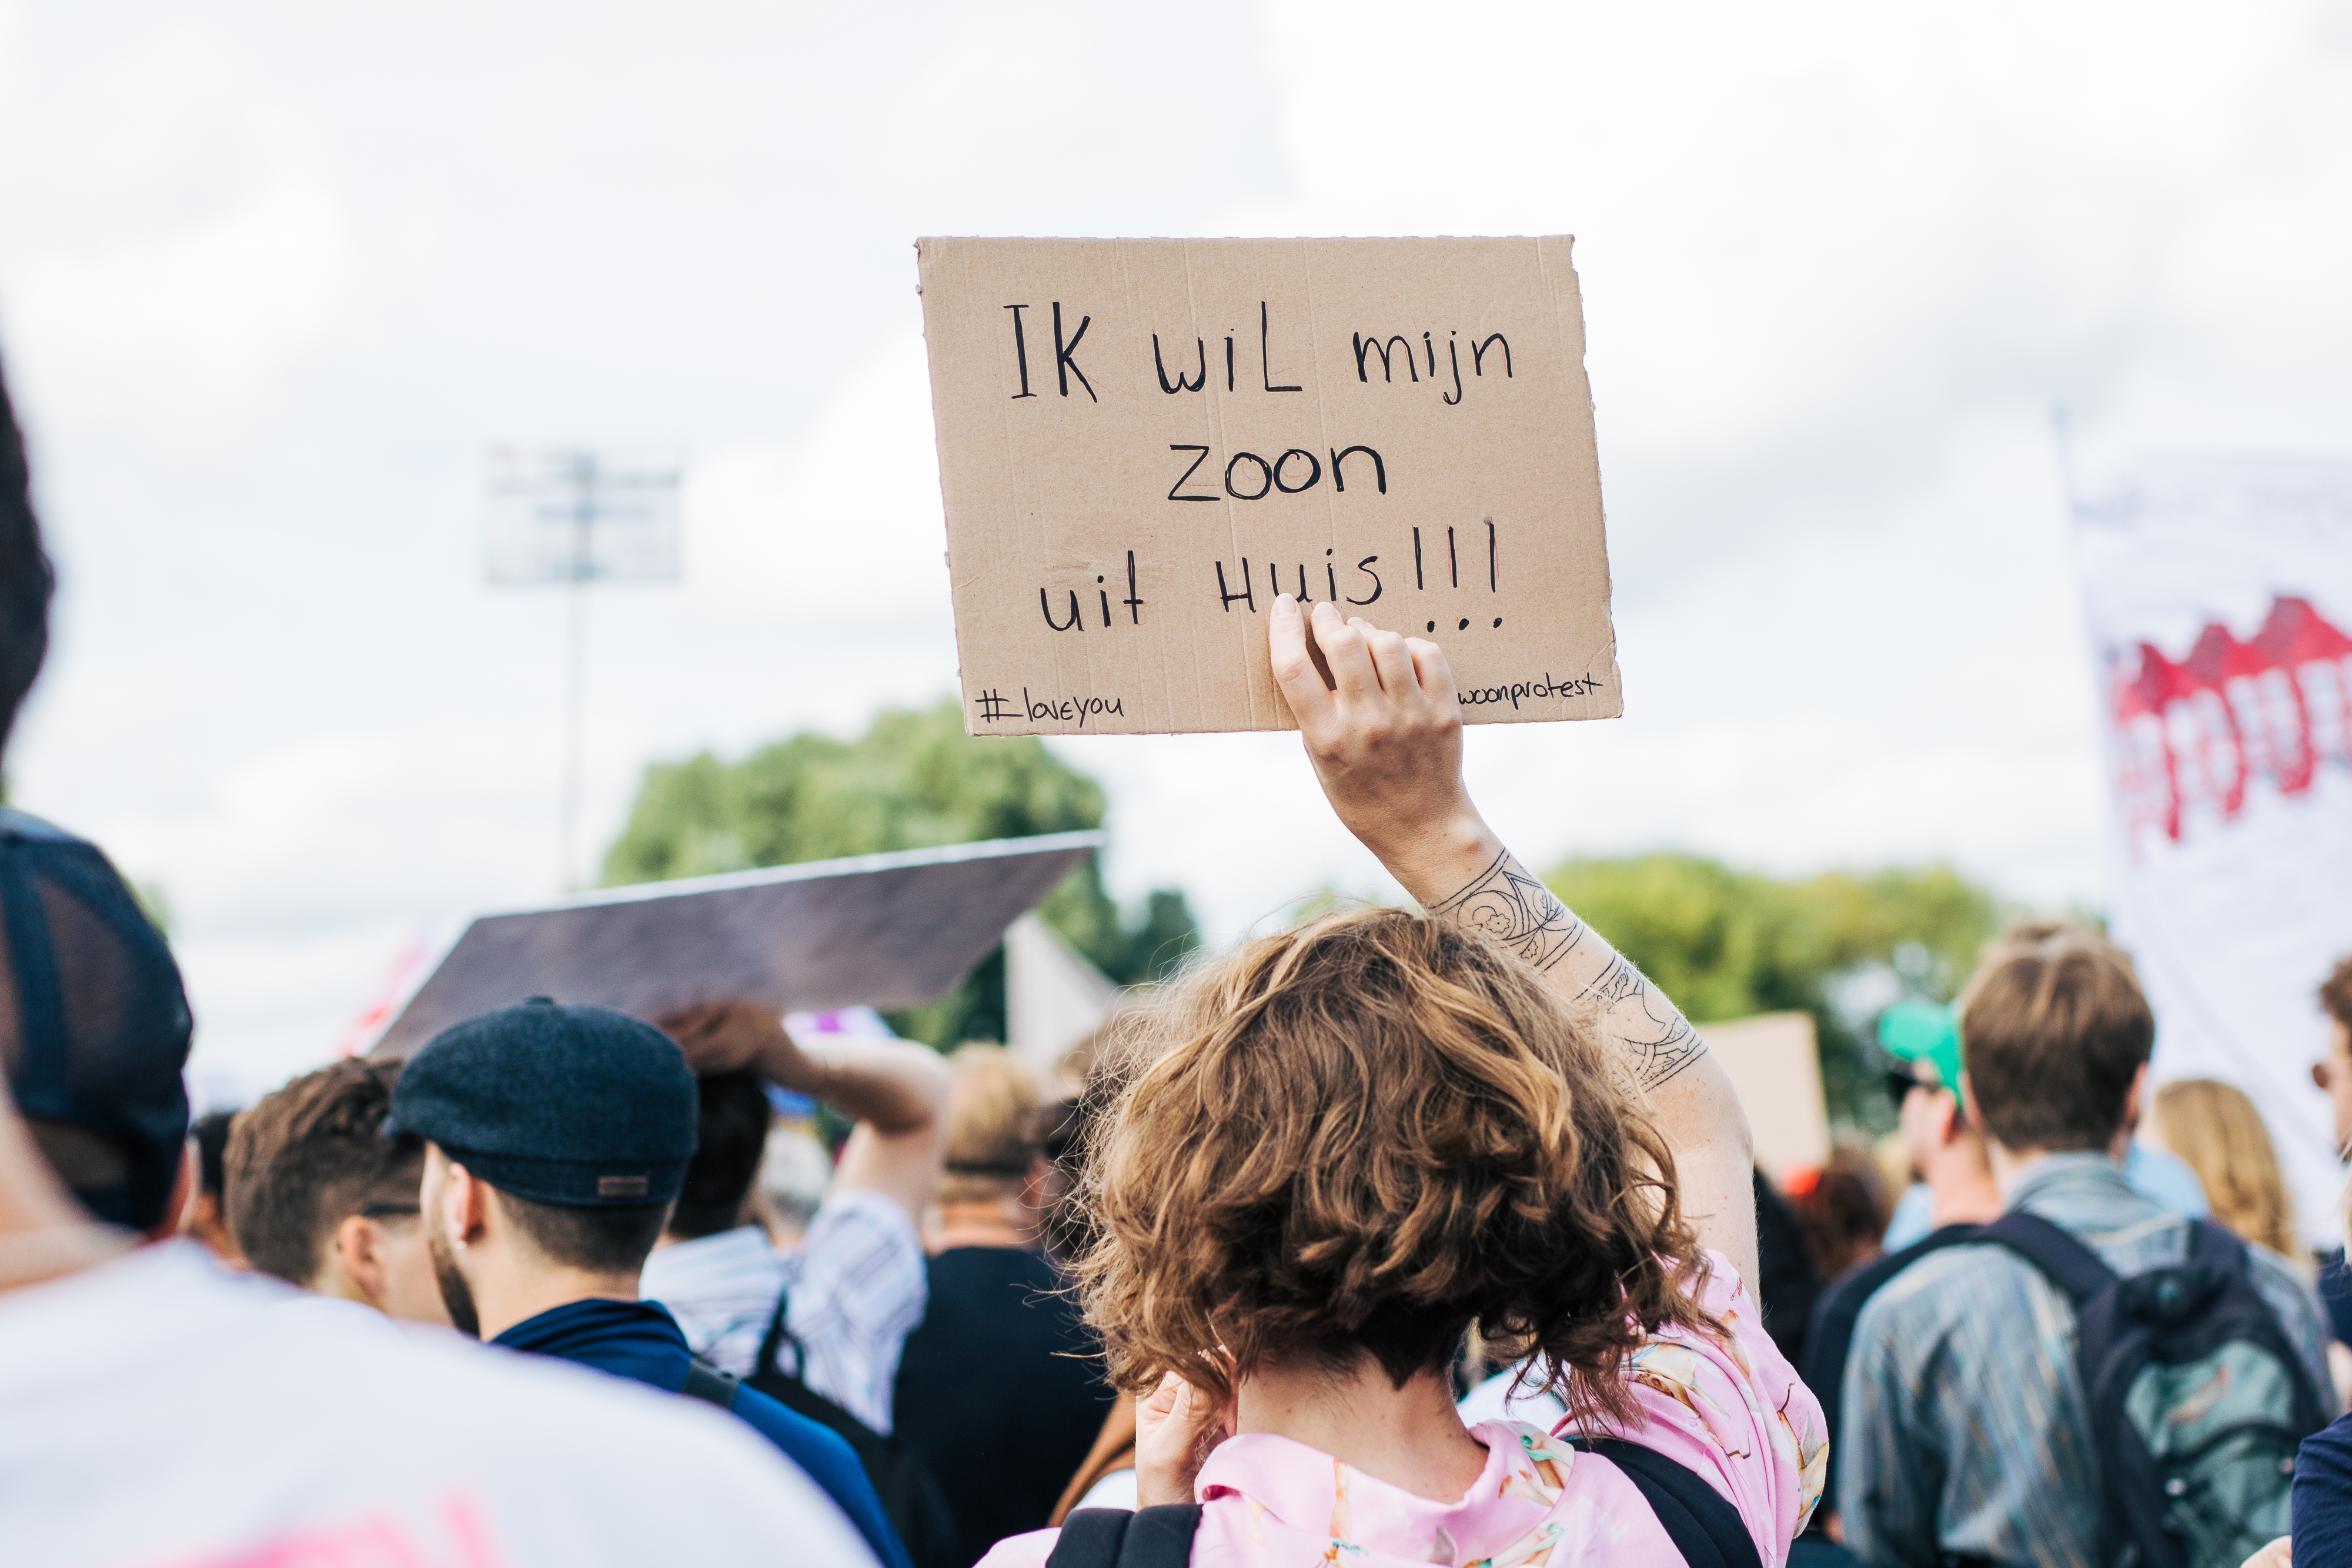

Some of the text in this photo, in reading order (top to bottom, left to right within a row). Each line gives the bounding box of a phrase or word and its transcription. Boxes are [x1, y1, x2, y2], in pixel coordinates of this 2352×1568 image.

[1352, 330, 1514, 406] mijn
[1167, 444, 1387, 502] zoon
[1039, 549, 1144, 632] uit
[974, 686, 1125, 728] #loveyou
